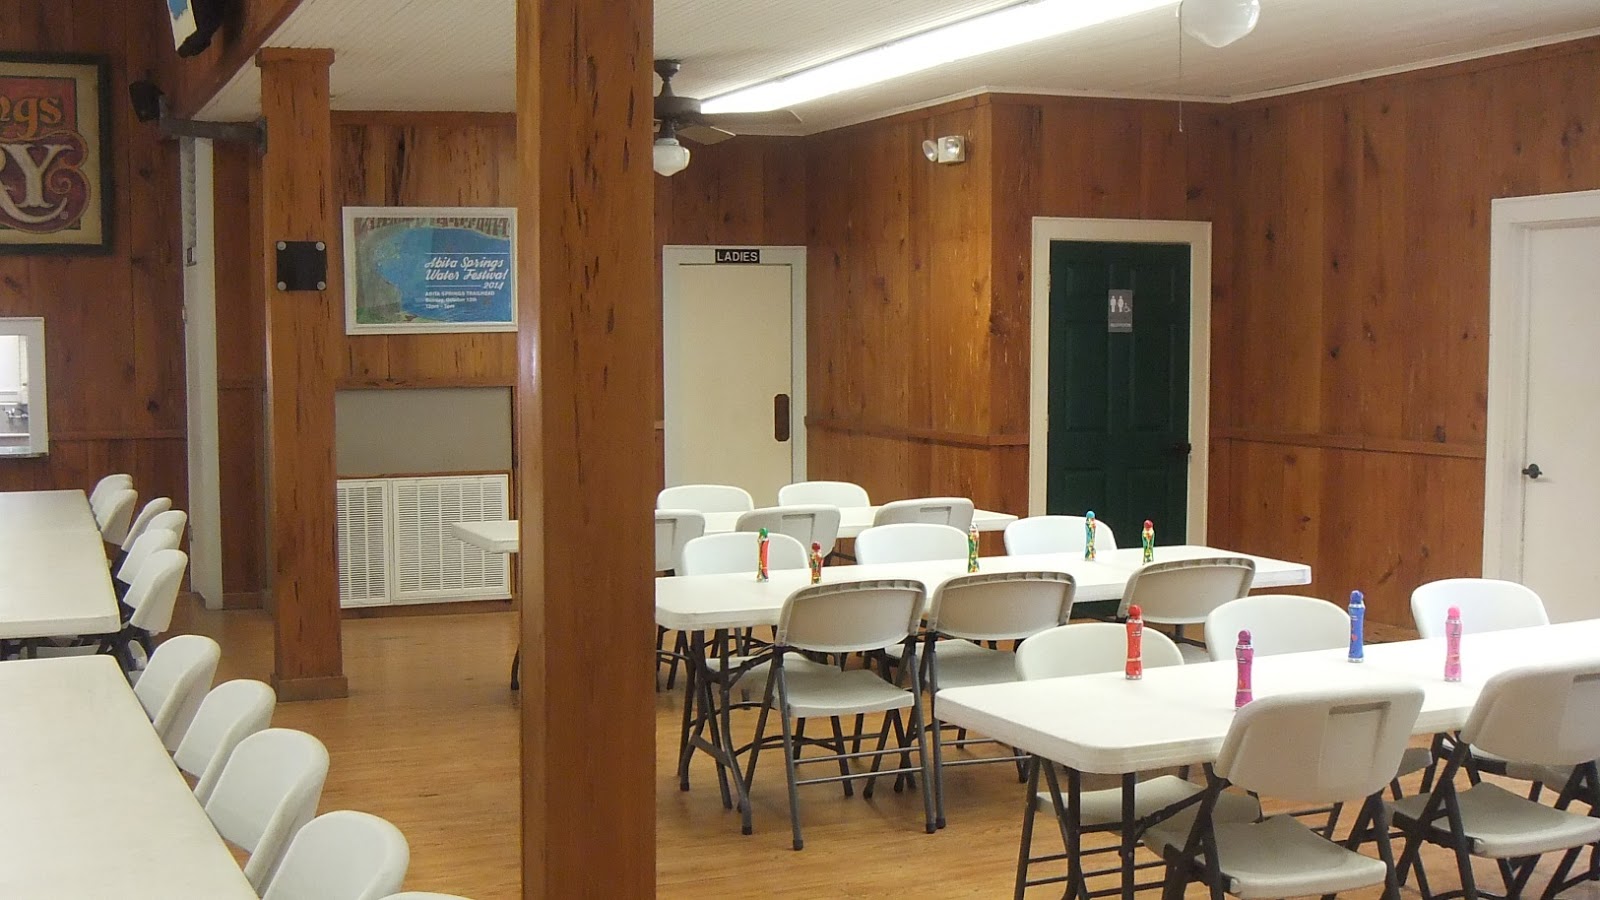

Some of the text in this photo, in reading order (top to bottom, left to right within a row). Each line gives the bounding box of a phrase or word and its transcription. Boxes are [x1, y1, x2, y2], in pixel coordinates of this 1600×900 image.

[717, 251, 758, 262] LADIES
[425, 257, 504, 271] Abita Springs
[425, 269, 509, 280] Water Festival
[483, 282, 504, 290] 2014
